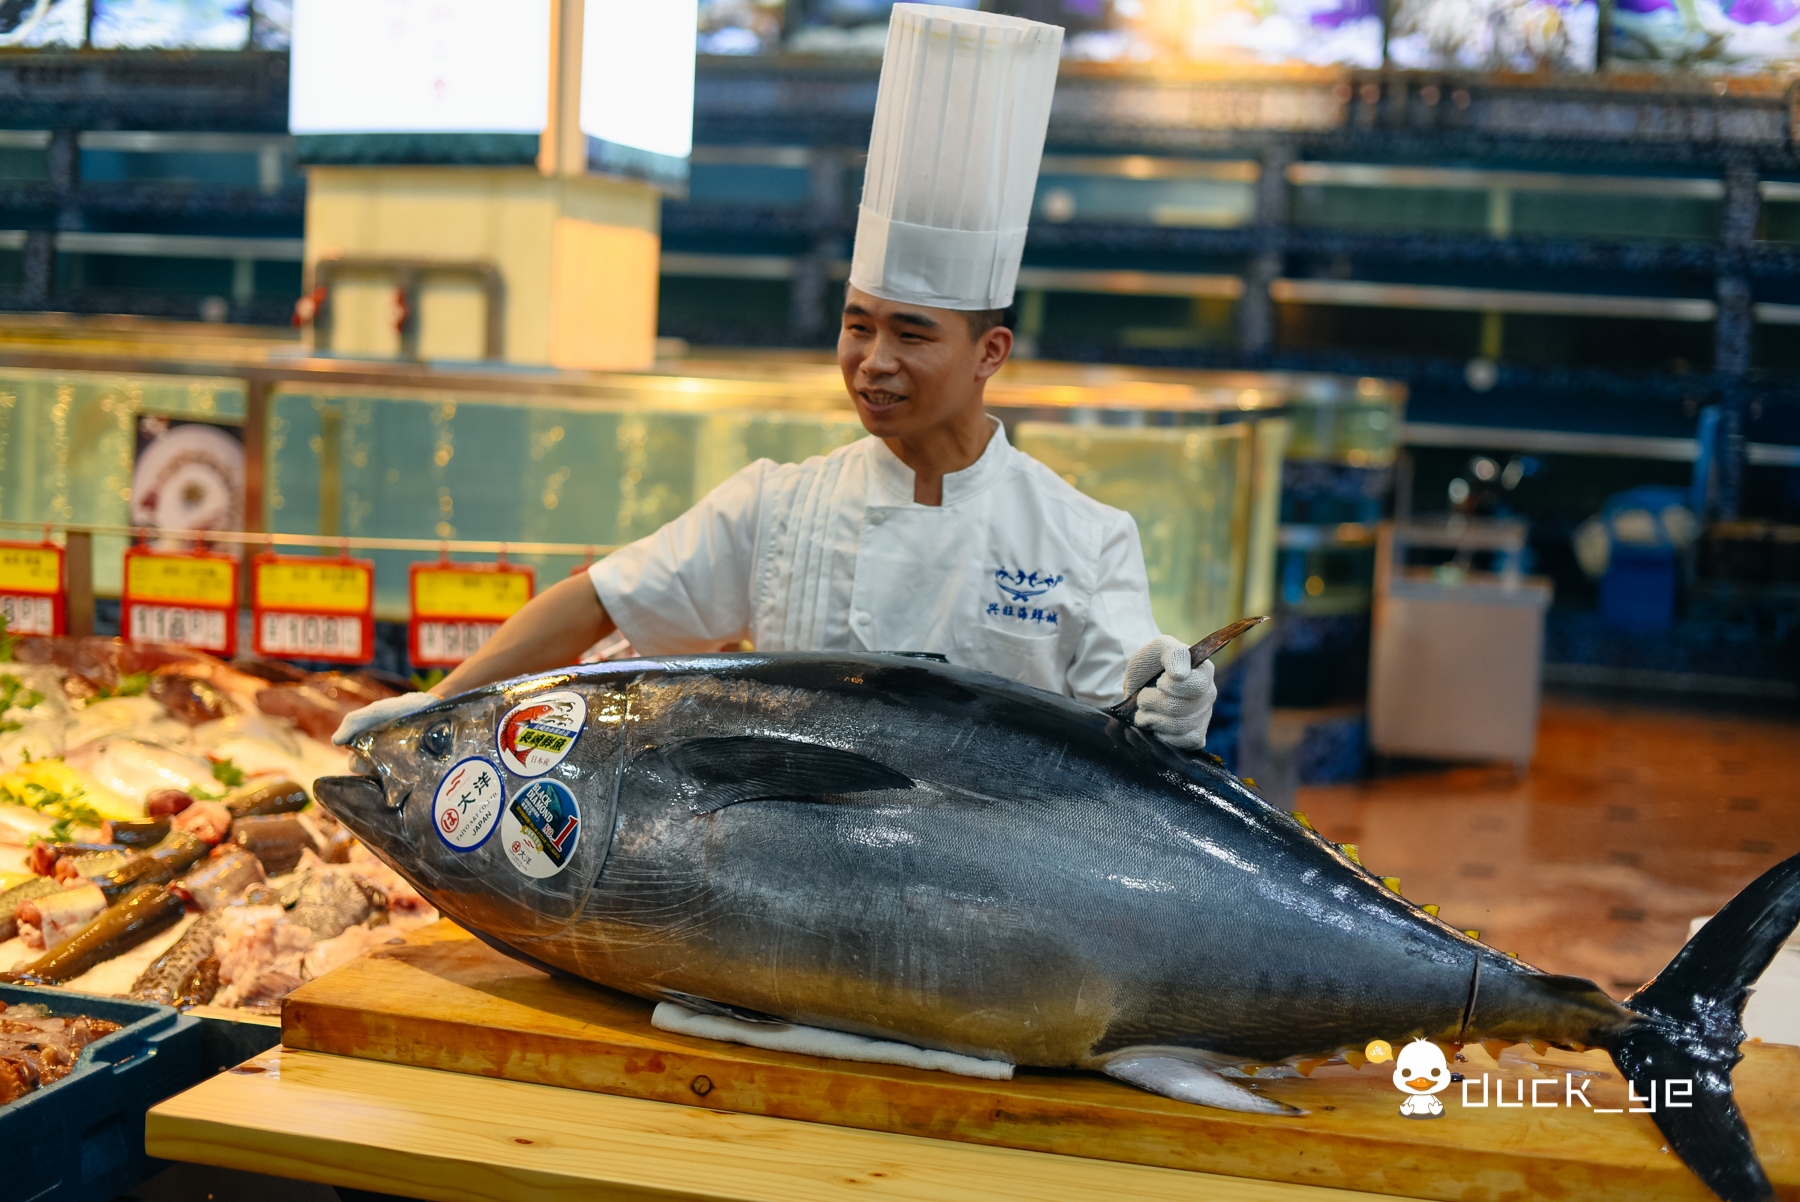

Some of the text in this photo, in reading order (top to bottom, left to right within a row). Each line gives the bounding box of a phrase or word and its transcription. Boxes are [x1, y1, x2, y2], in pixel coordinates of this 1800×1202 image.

[519, 731, 567, 751] 長崎鮮魚
[531, 755, 550, 766] 日本産
[457, 771, 491, 814] 大洋
[526, 788, 554, 822] DIAMOND
[532, 782, 552, 807] BLACK
[472, 811, 492, 836] JAPAN
[542, 823, 555, 840] NO.
[551, 815, 579, 852] 1
[518, 850, 532, 865] 大洋
